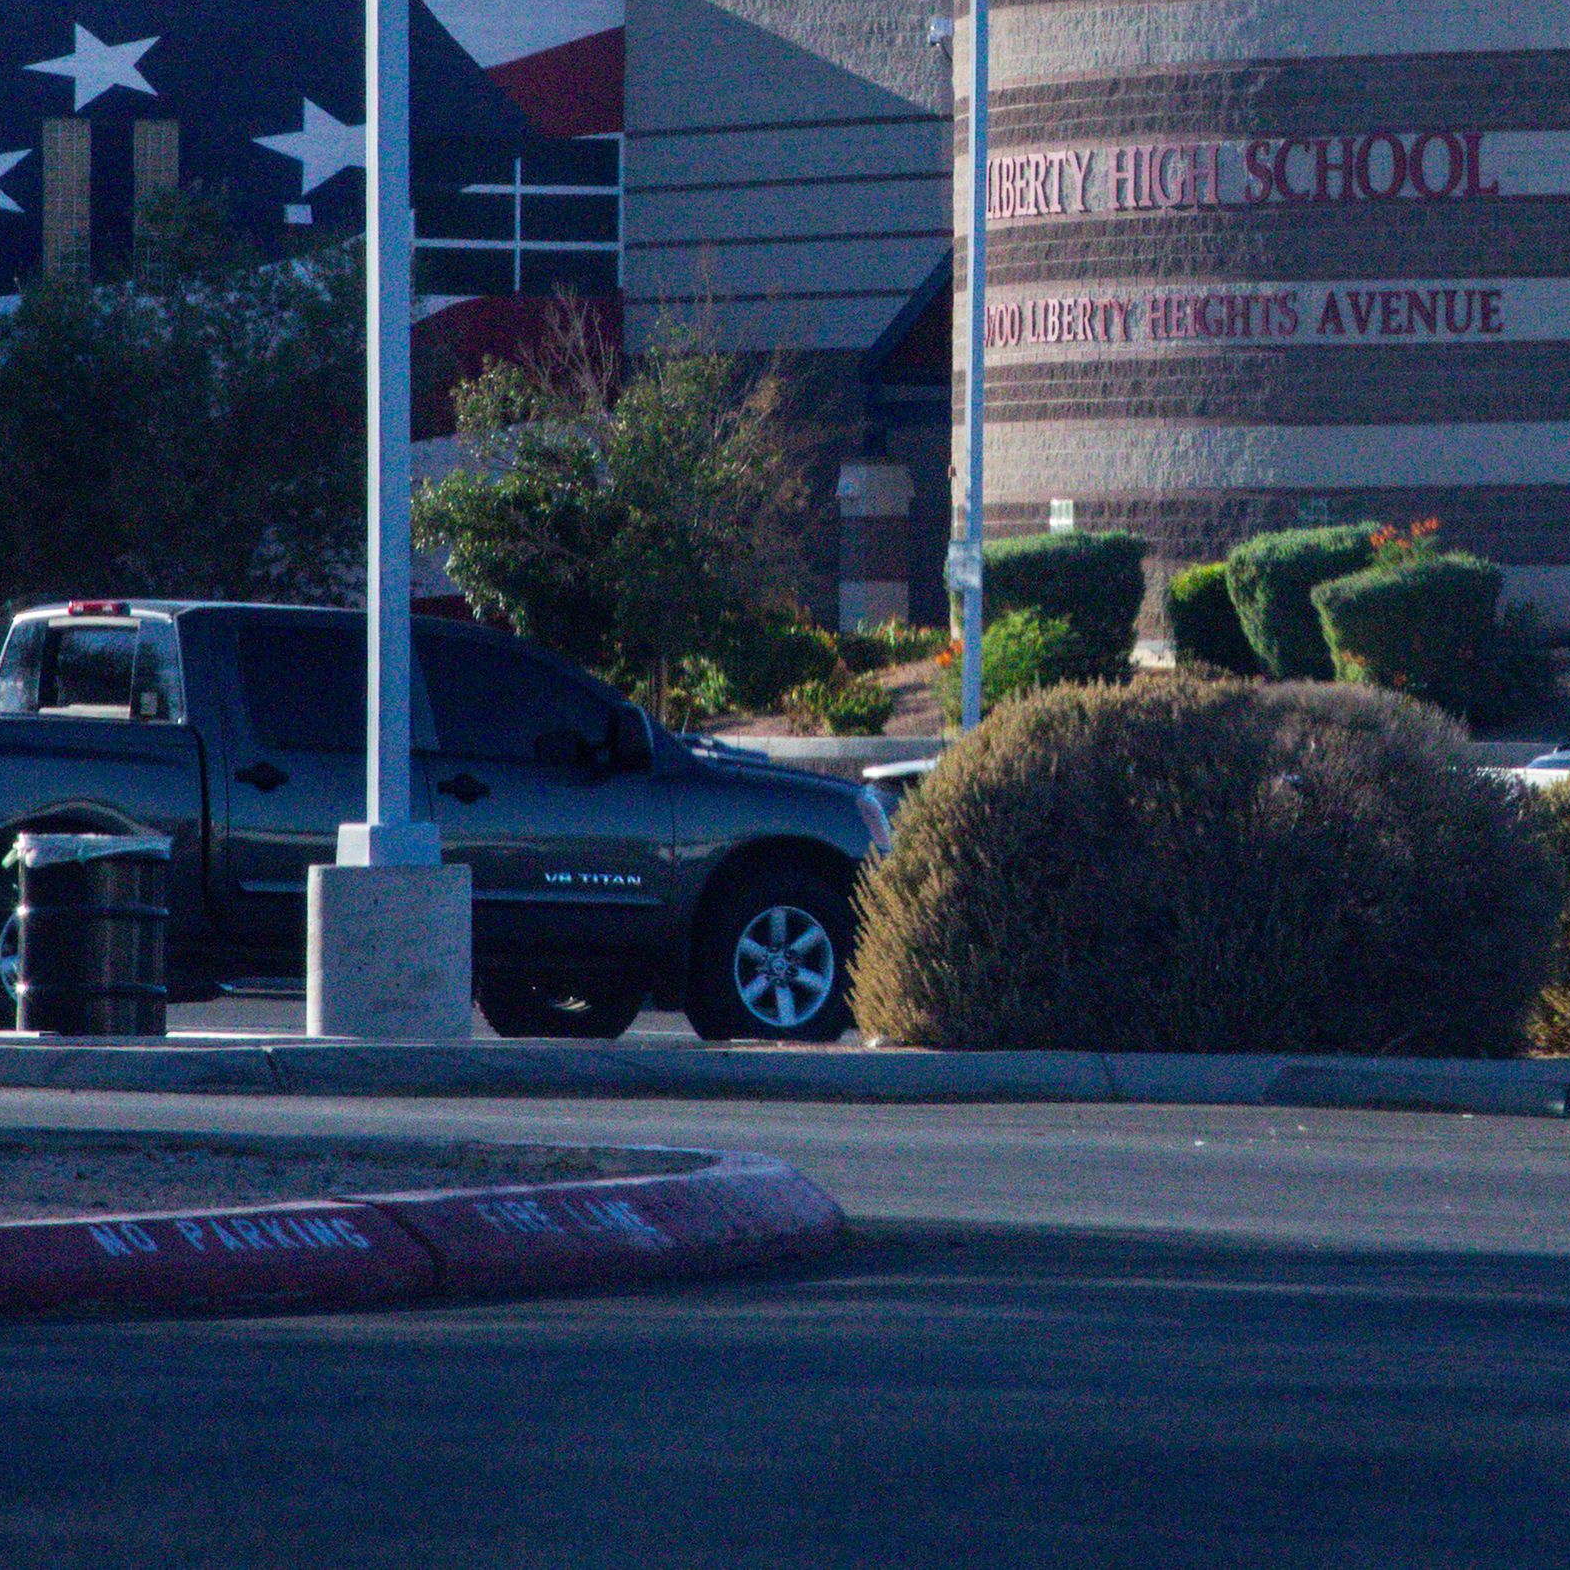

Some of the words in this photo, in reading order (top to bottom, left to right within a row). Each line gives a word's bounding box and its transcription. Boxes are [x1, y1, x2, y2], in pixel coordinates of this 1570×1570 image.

[986, 149, 1094, 220] LIBERTY
[1108, 143, 1220, 210] HIGH
[1245, 131, 1500, 204] SCHOOL
[1027, 296, 1130, 343] LIBERTY
[1144, 290, 1299, 340] HEIGHTS
[1316, 288, 1504, 336] AVENUE
[578, 872, 641, 885] TITAN
[89, 1221, 158, 1256] NO
[175, 1217, 372, 1251] PARKING
